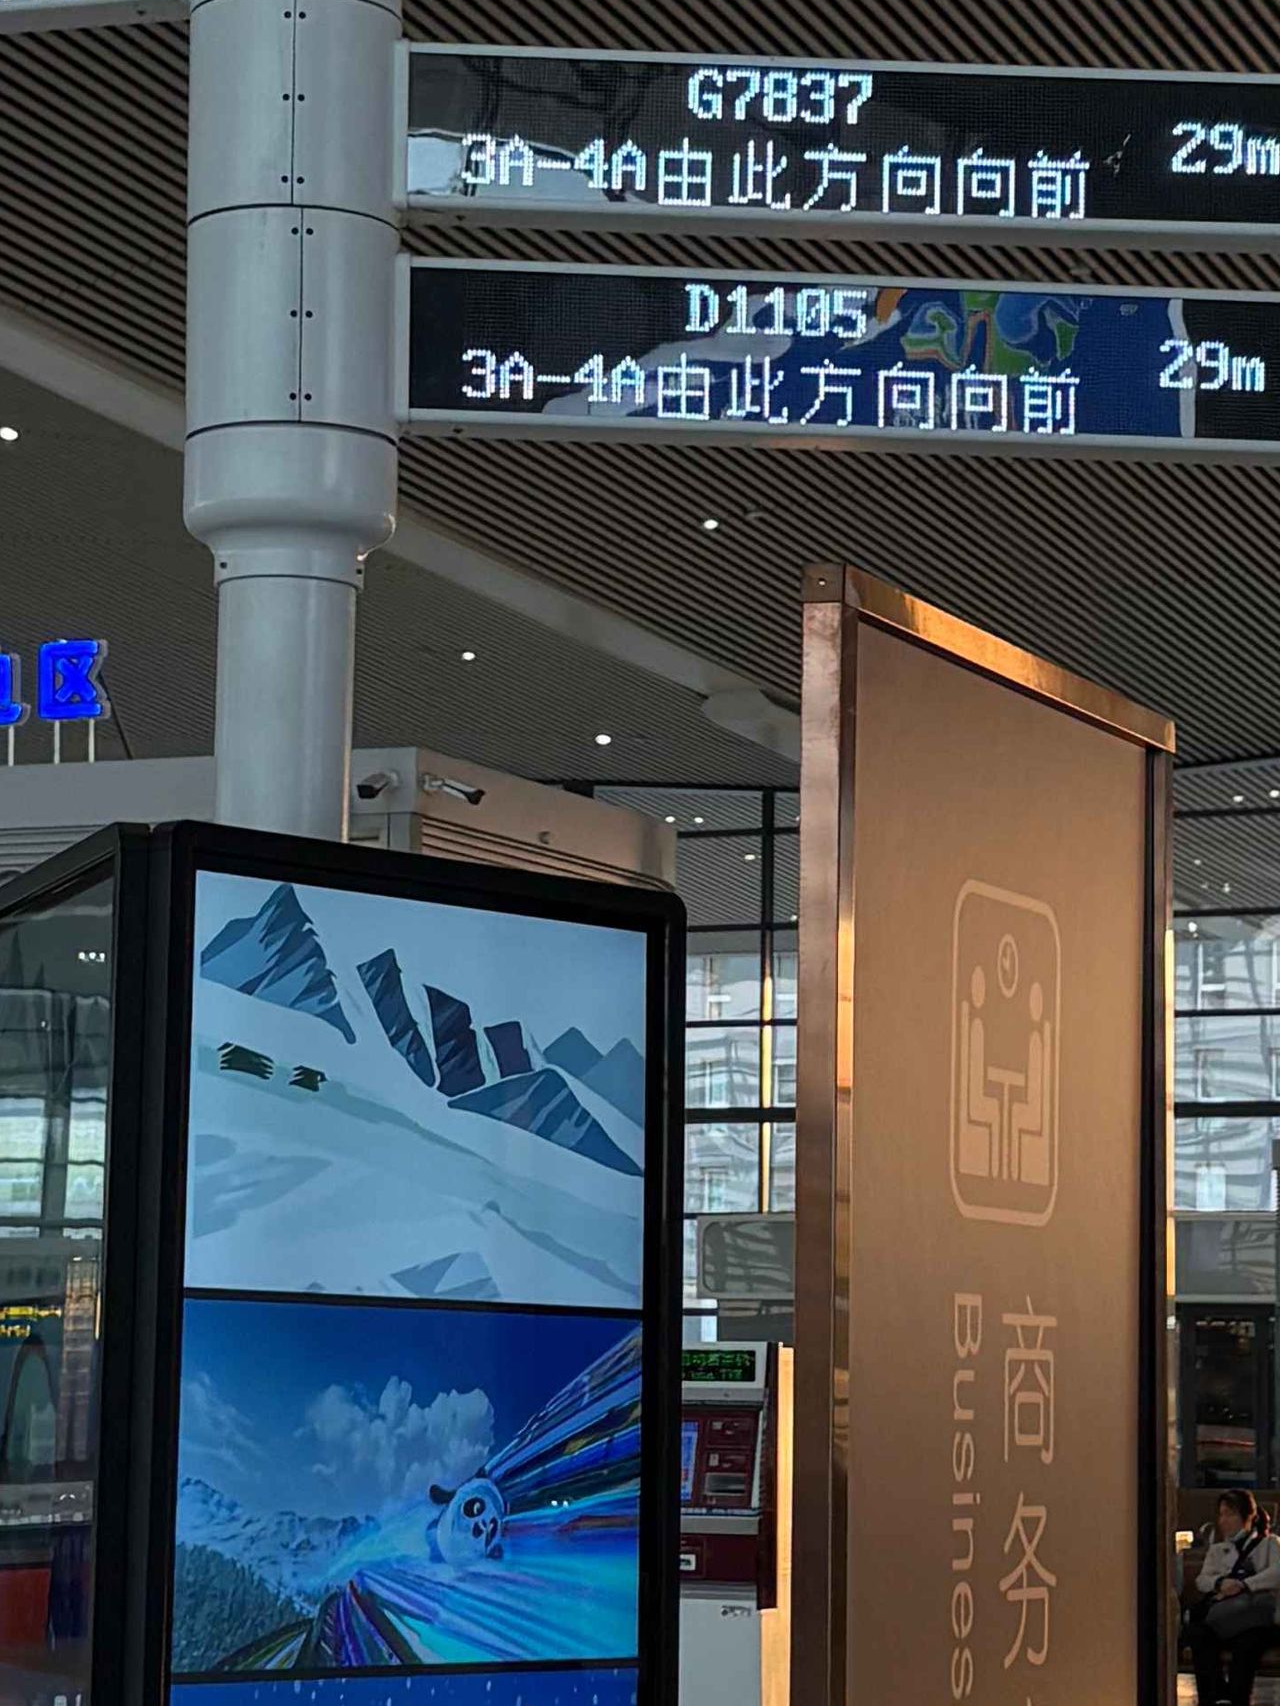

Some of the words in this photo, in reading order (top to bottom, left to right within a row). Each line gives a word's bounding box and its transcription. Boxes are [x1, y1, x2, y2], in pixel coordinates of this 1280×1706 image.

[687, 68, 874, 125] G7837
[684, 283, 868, 339] D1105
[1158, 338, 1266, 393] 29m
